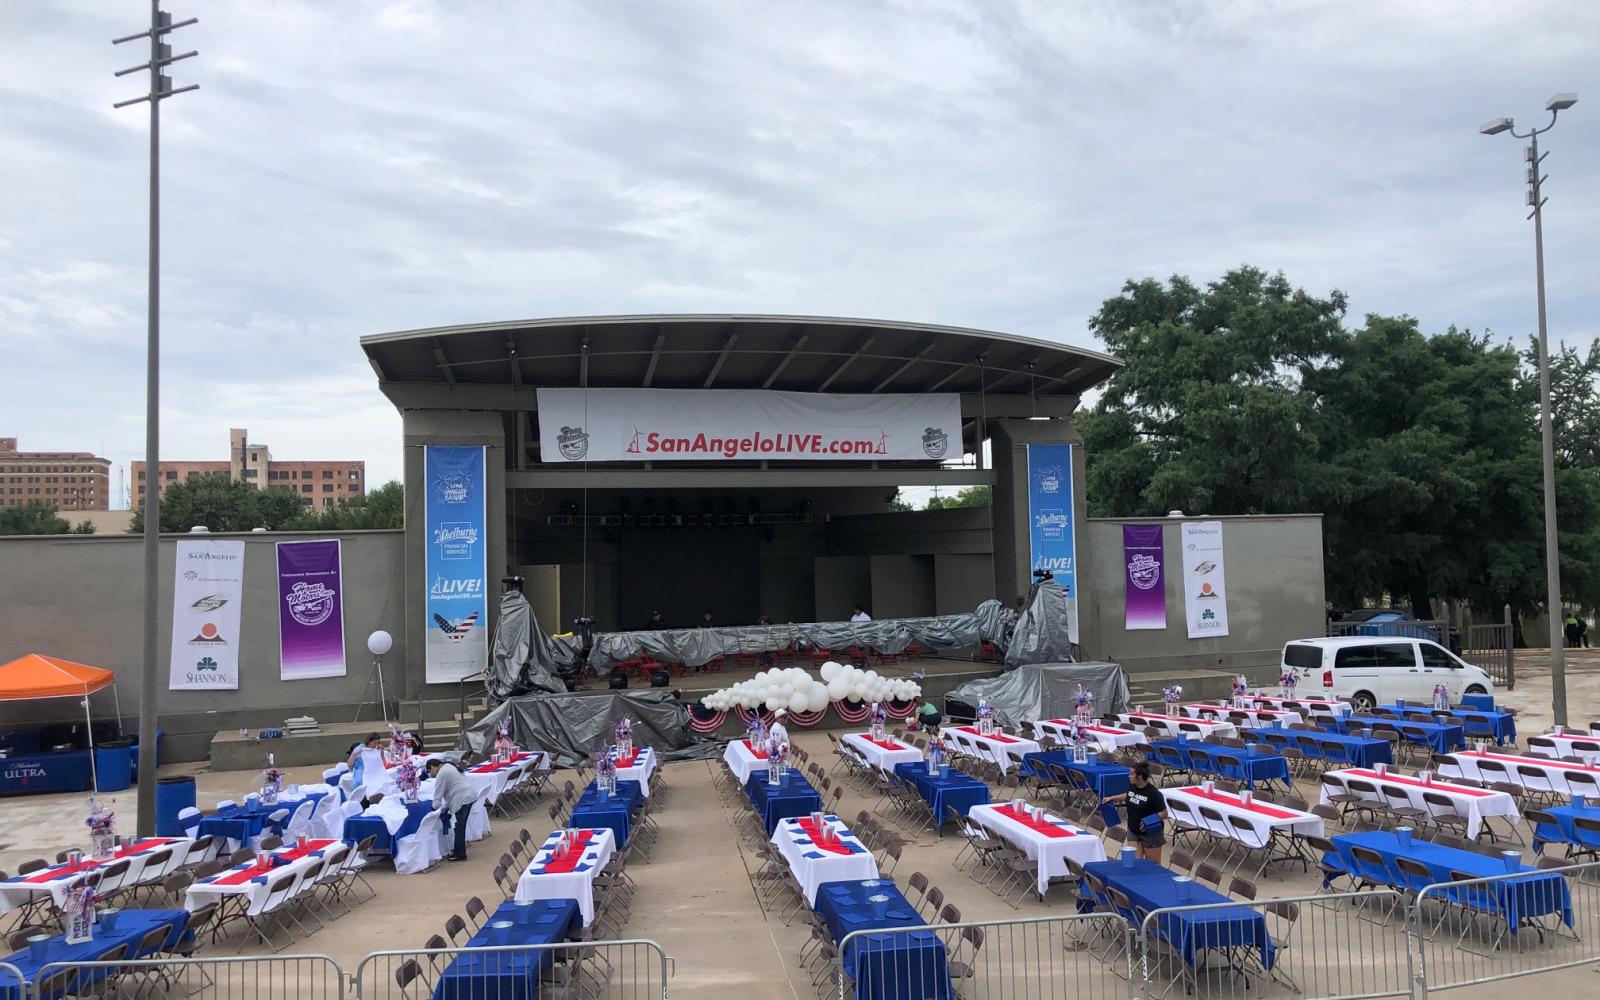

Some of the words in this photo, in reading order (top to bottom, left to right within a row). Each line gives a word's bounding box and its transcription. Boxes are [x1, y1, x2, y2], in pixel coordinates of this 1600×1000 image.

[646, 432, 873, 457] SanAngeloLIVE.com
[1044, 557, 1072, 569] LIVE!
[292, 582, 325, 594] Home
[443, 579, 481, 592] LIVE!
[185, 672, 226, 683] SHANNON
[4, 769, 47, 778] ULTRA
